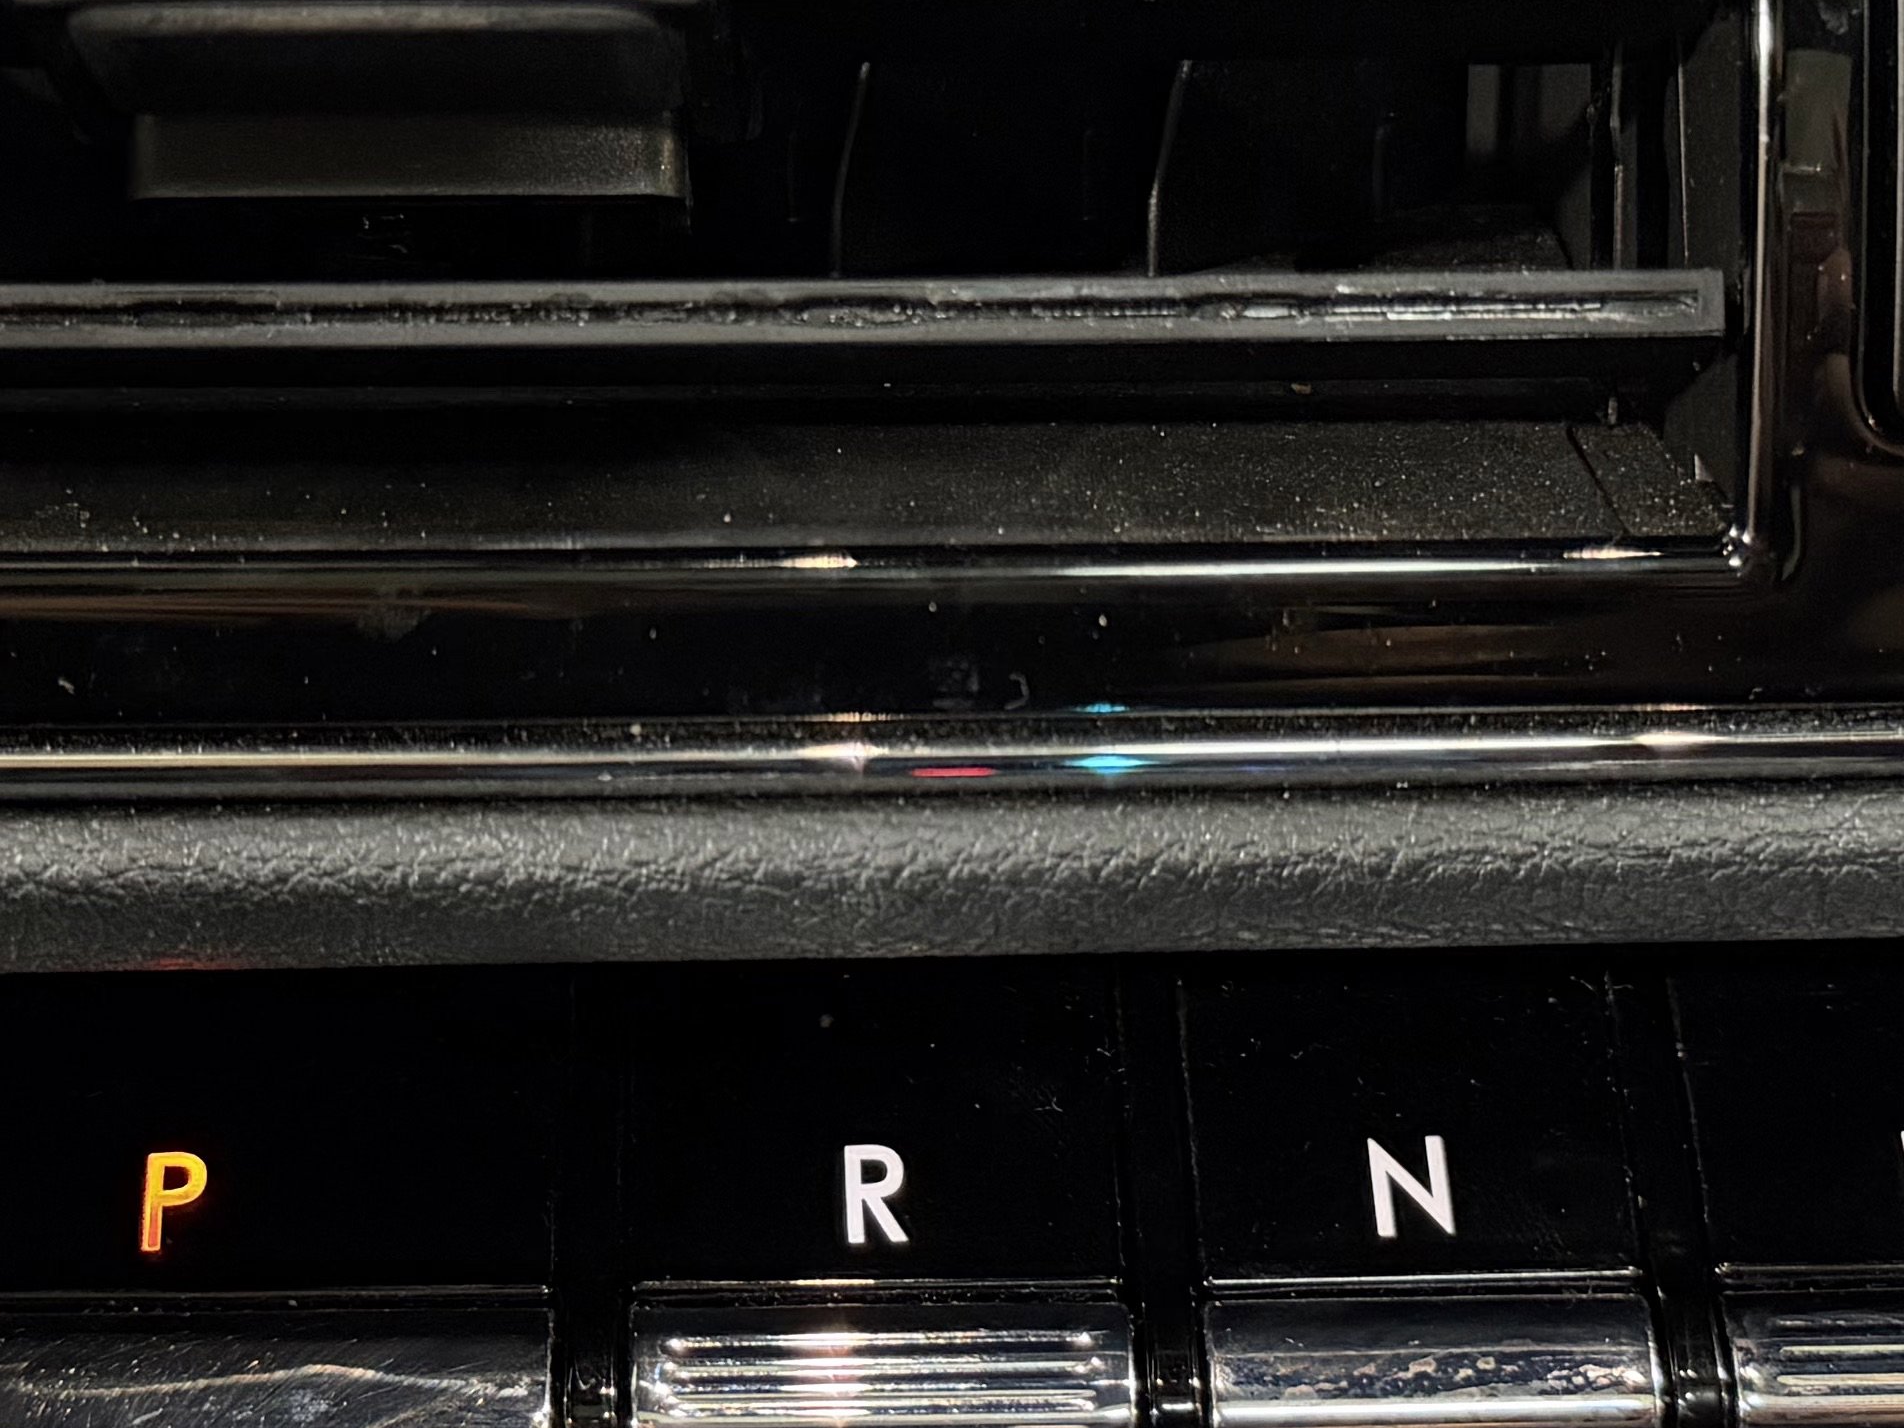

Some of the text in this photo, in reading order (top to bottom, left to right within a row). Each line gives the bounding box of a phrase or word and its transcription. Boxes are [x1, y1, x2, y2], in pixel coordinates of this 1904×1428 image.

[140, 1151, 208, 1253] P
[844, 1143, 909, 1245] R
[1366, 1135, 1455, 1238] N
